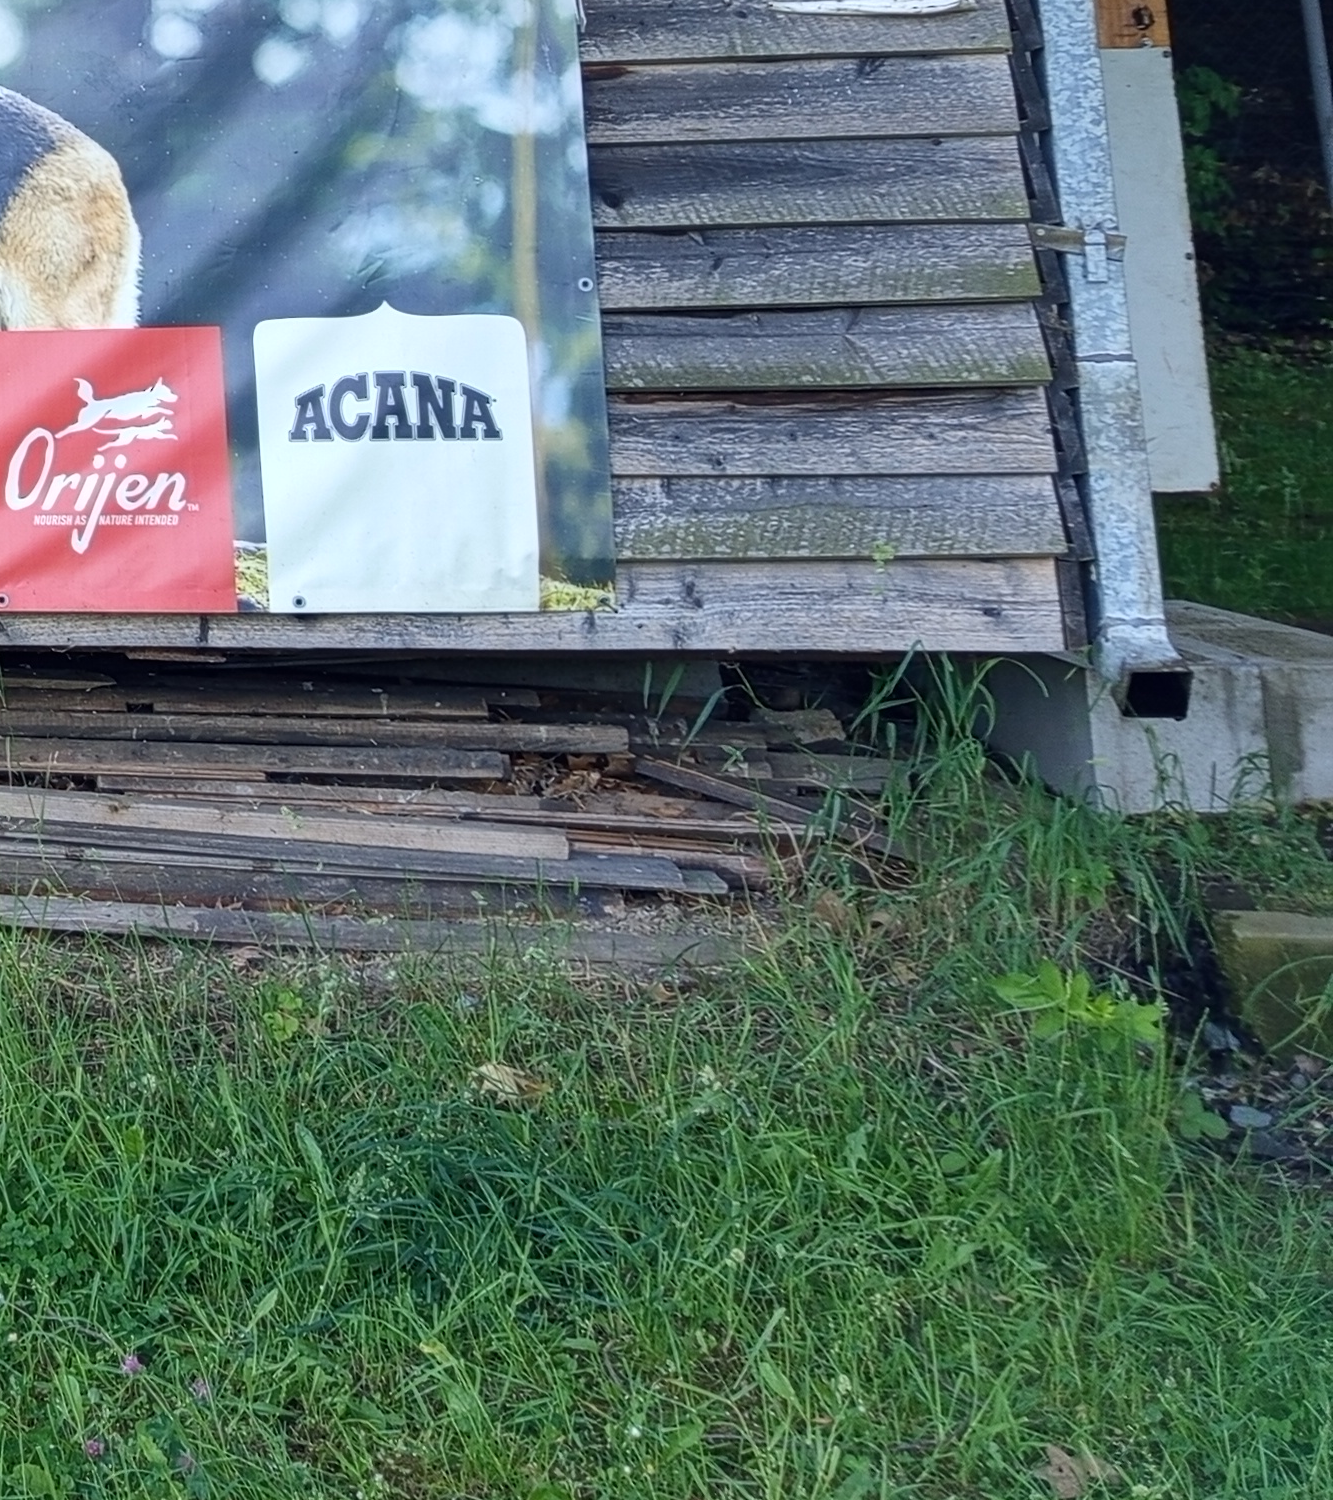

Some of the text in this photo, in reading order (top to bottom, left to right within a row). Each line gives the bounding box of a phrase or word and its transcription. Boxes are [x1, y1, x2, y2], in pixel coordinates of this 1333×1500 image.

[288, 369, 503, 443] ACANA
[5, 427, 187, 554] Orijen
[33, 513, 179, 526] NOURISH AS NATURE INTENDED
